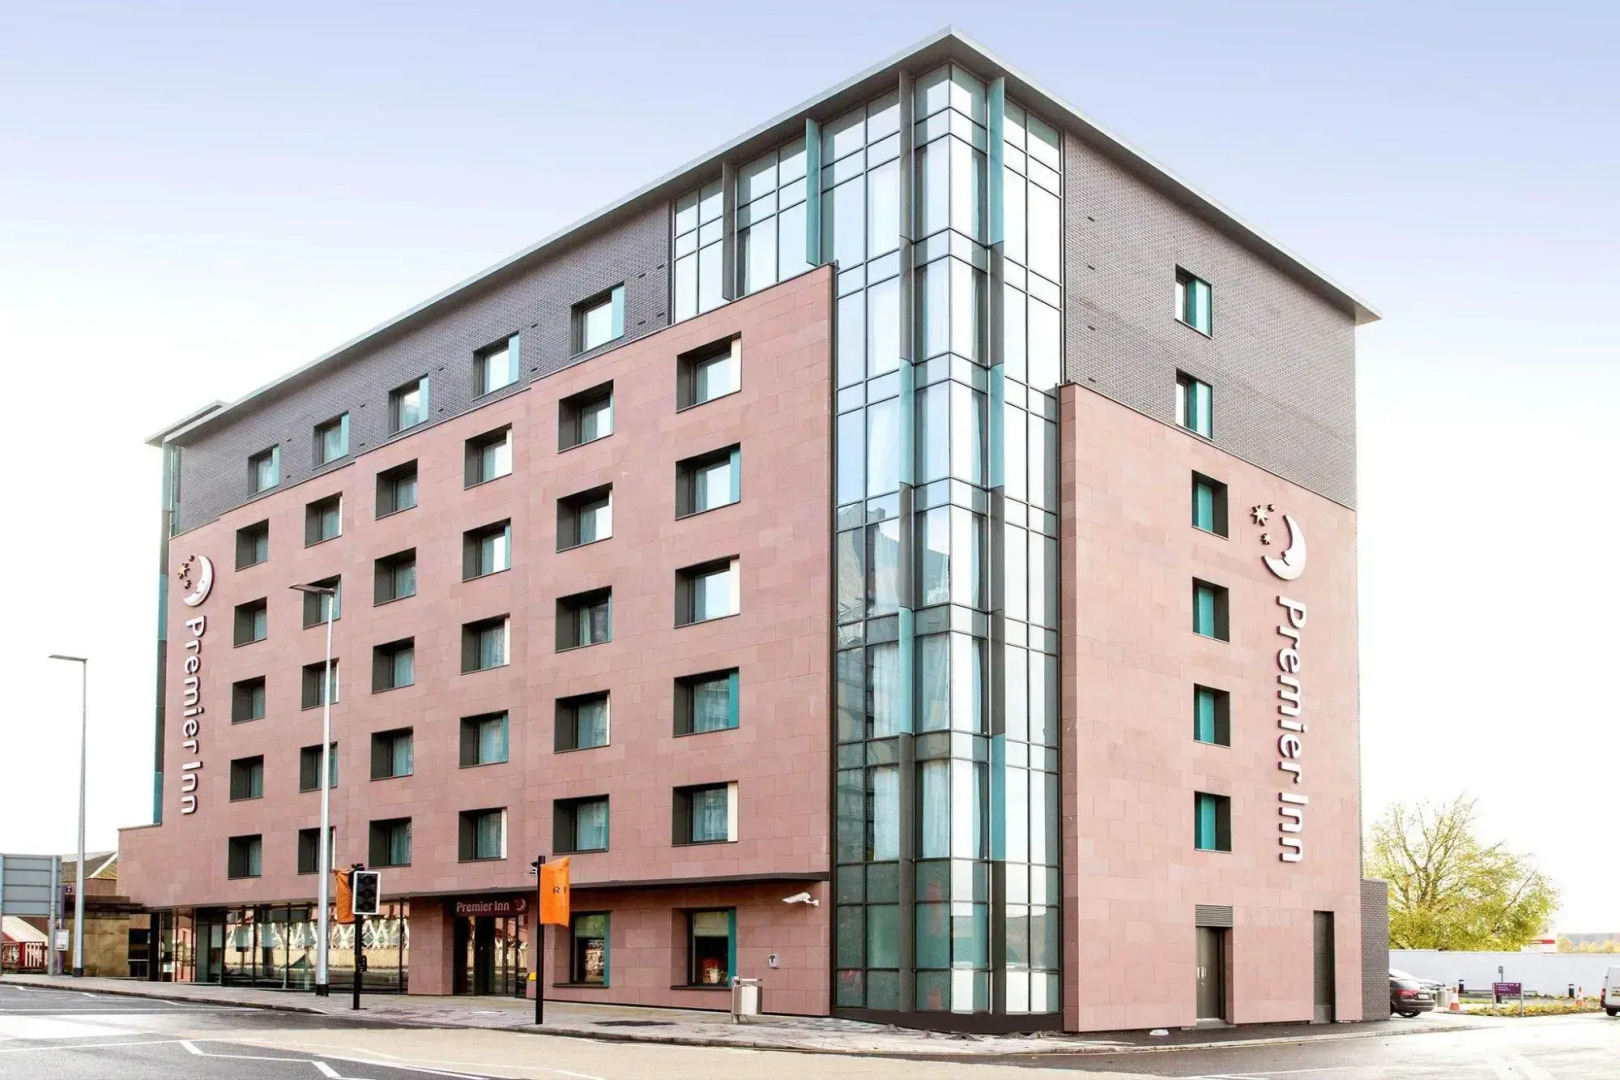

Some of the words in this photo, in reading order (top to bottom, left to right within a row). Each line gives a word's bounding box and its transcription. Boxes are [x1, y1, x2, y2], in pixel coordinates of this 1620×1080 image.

[183, 615, 206, 754] Premier
[1276, 595, 1308, 784] Premier
[181, 761, 203, 815] Inn
[1278, 792, 1310, 863] Inn
[456, 901, 491, 912] Premier
[494, 901, 510, 911] Inn
